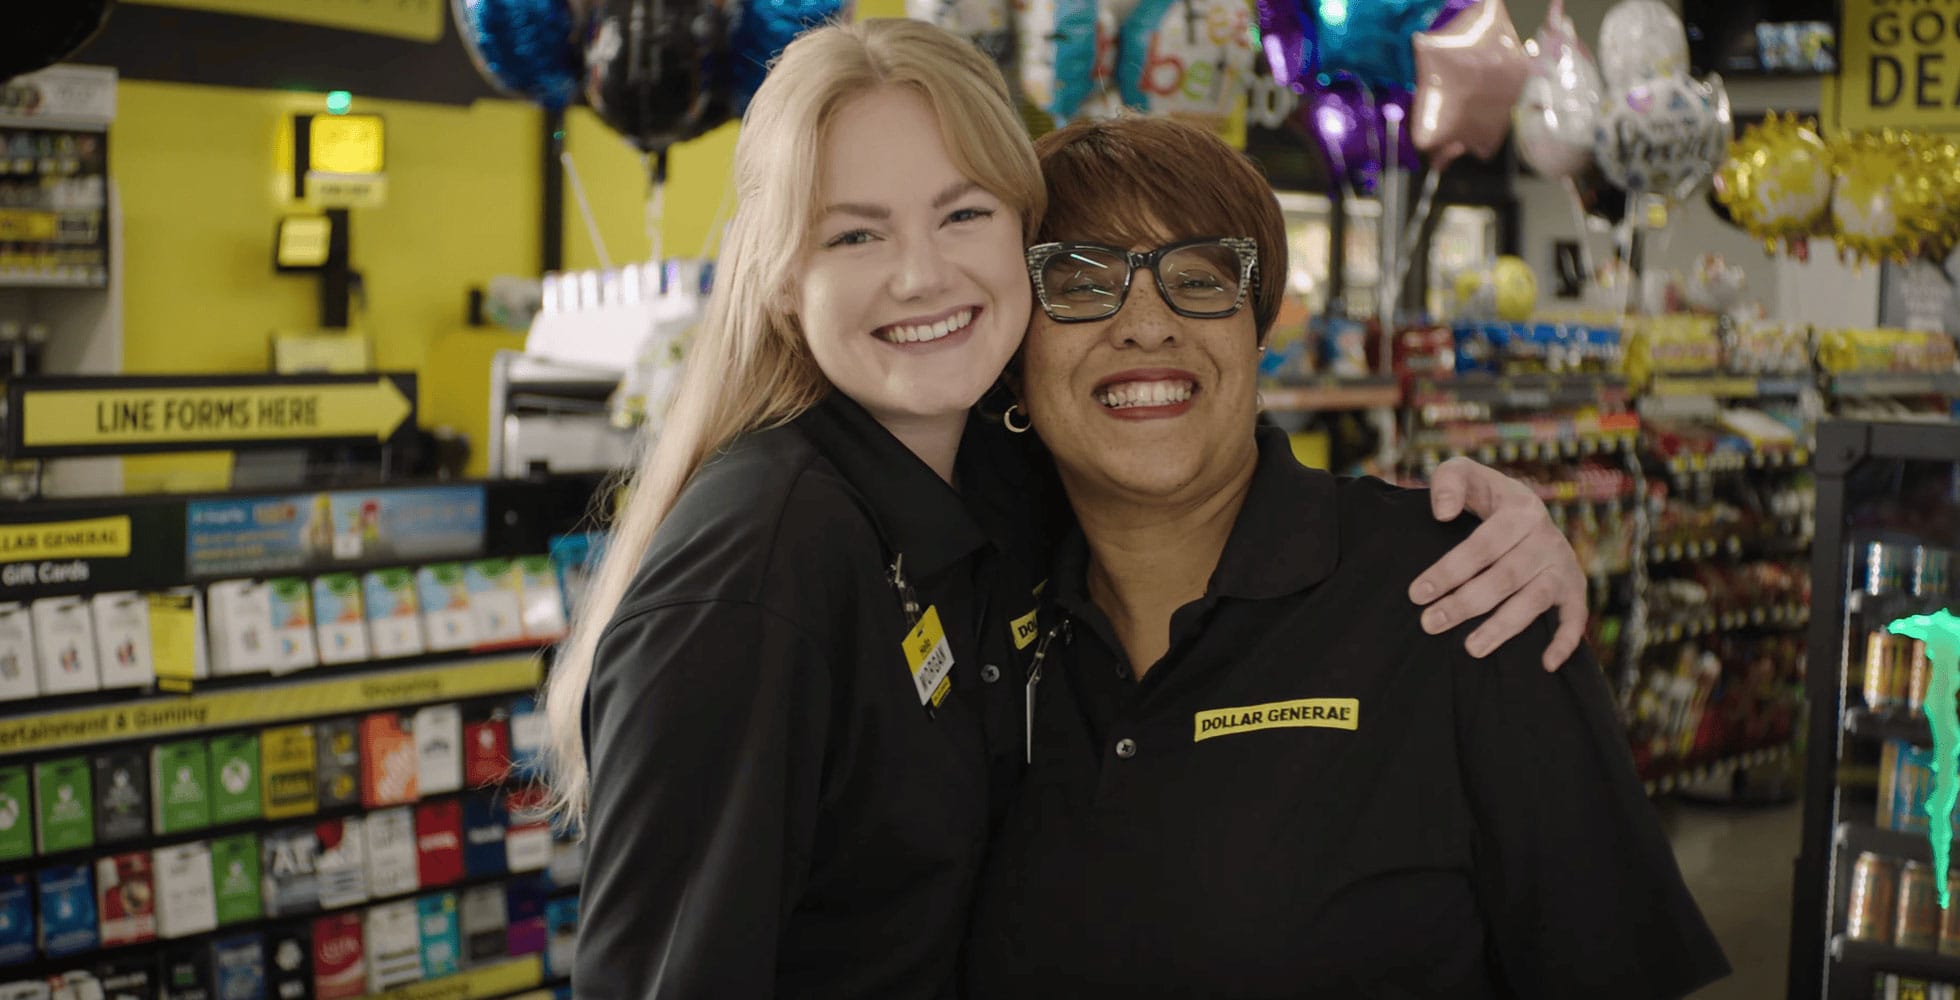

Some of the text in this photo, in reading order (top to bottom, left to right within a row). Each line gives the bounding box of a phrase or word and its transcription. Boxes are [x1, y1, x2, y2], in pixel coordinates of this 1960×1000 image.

[1869, 9, 1960, 46] GO
[97, 396, 319, 434] LINE FORMS HERE
[2, 559, 90, 586] Gift Cards
[1201, 706, 1351, 732] DOLLAR GENERAL
